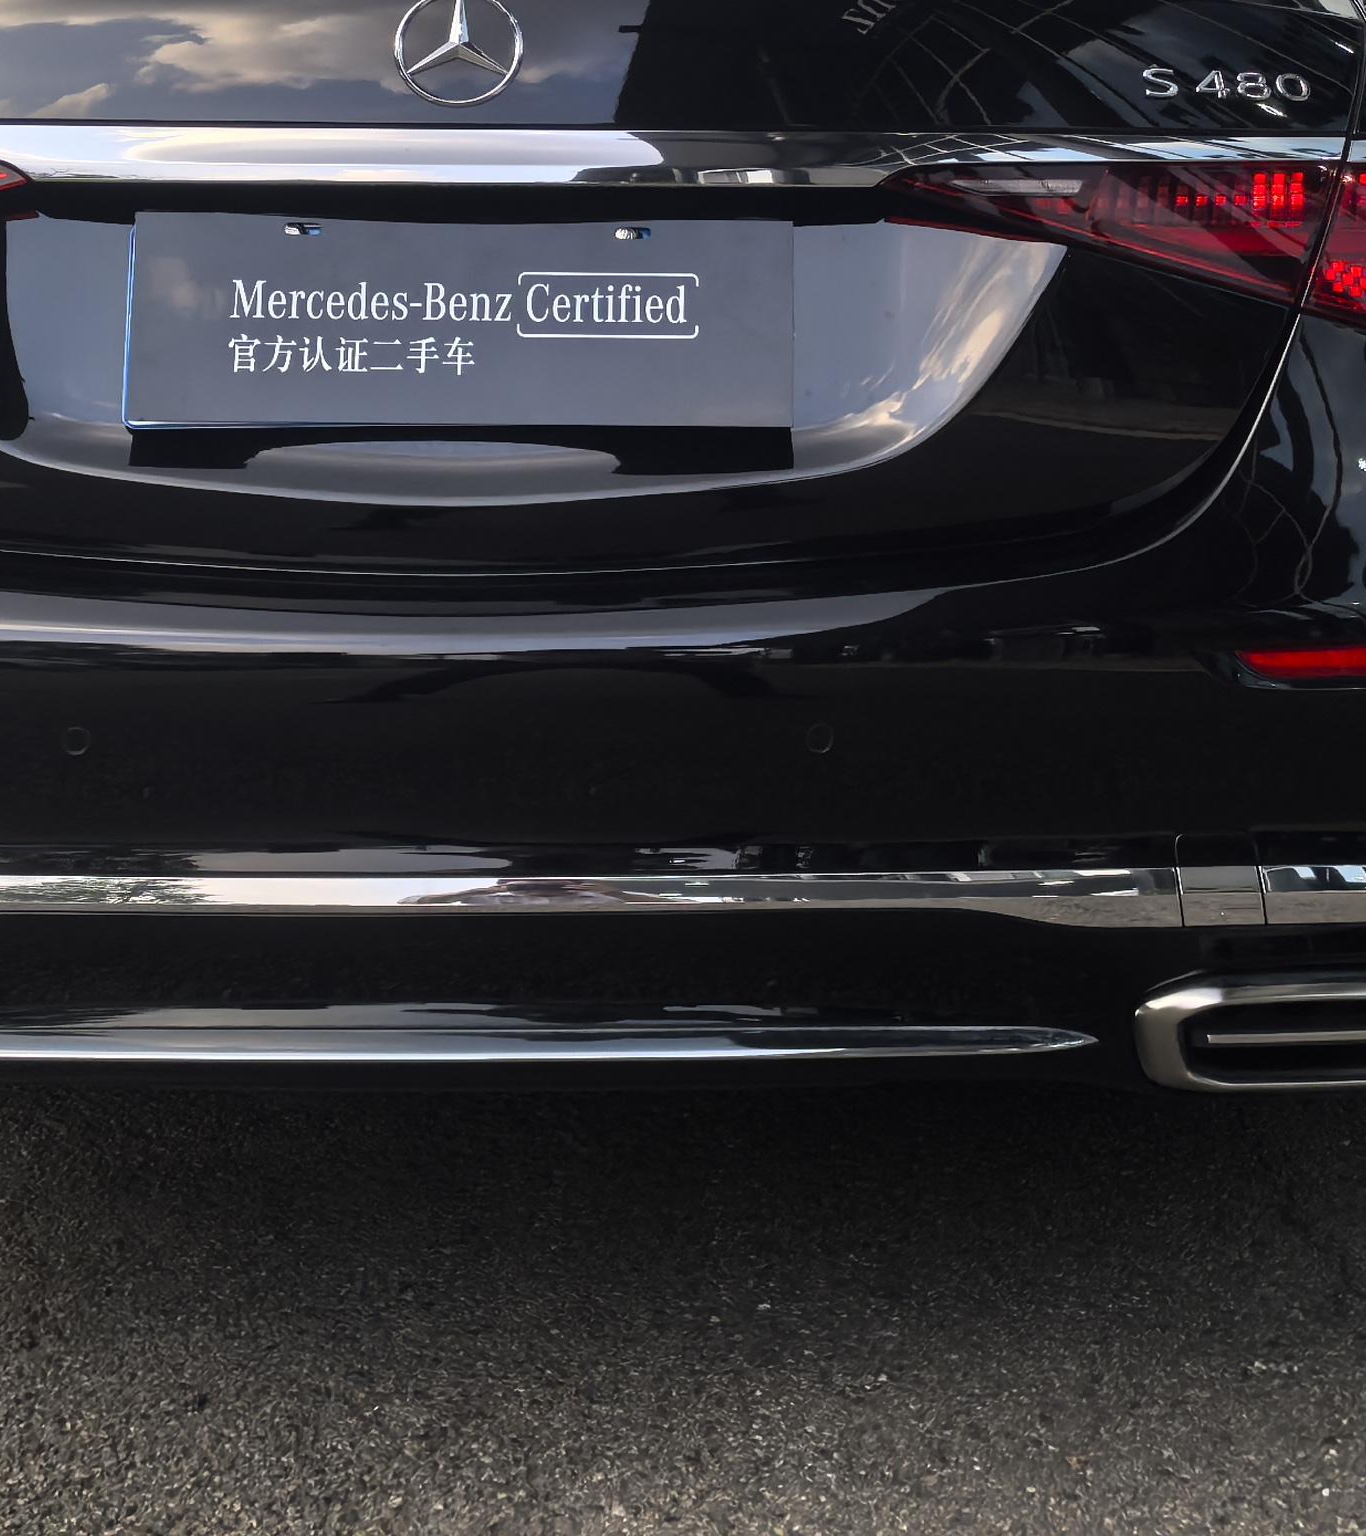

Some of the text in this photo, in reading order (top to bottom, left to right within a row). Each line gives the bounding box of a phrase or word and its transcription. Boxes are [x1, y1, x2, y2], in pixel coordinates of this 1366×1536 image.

[1142, 66, 1312, 103] S 480
[228, 278, 688, 325] Mercedes-Benz Certified
[228, 335, 476, 376] 官方认证二手车
